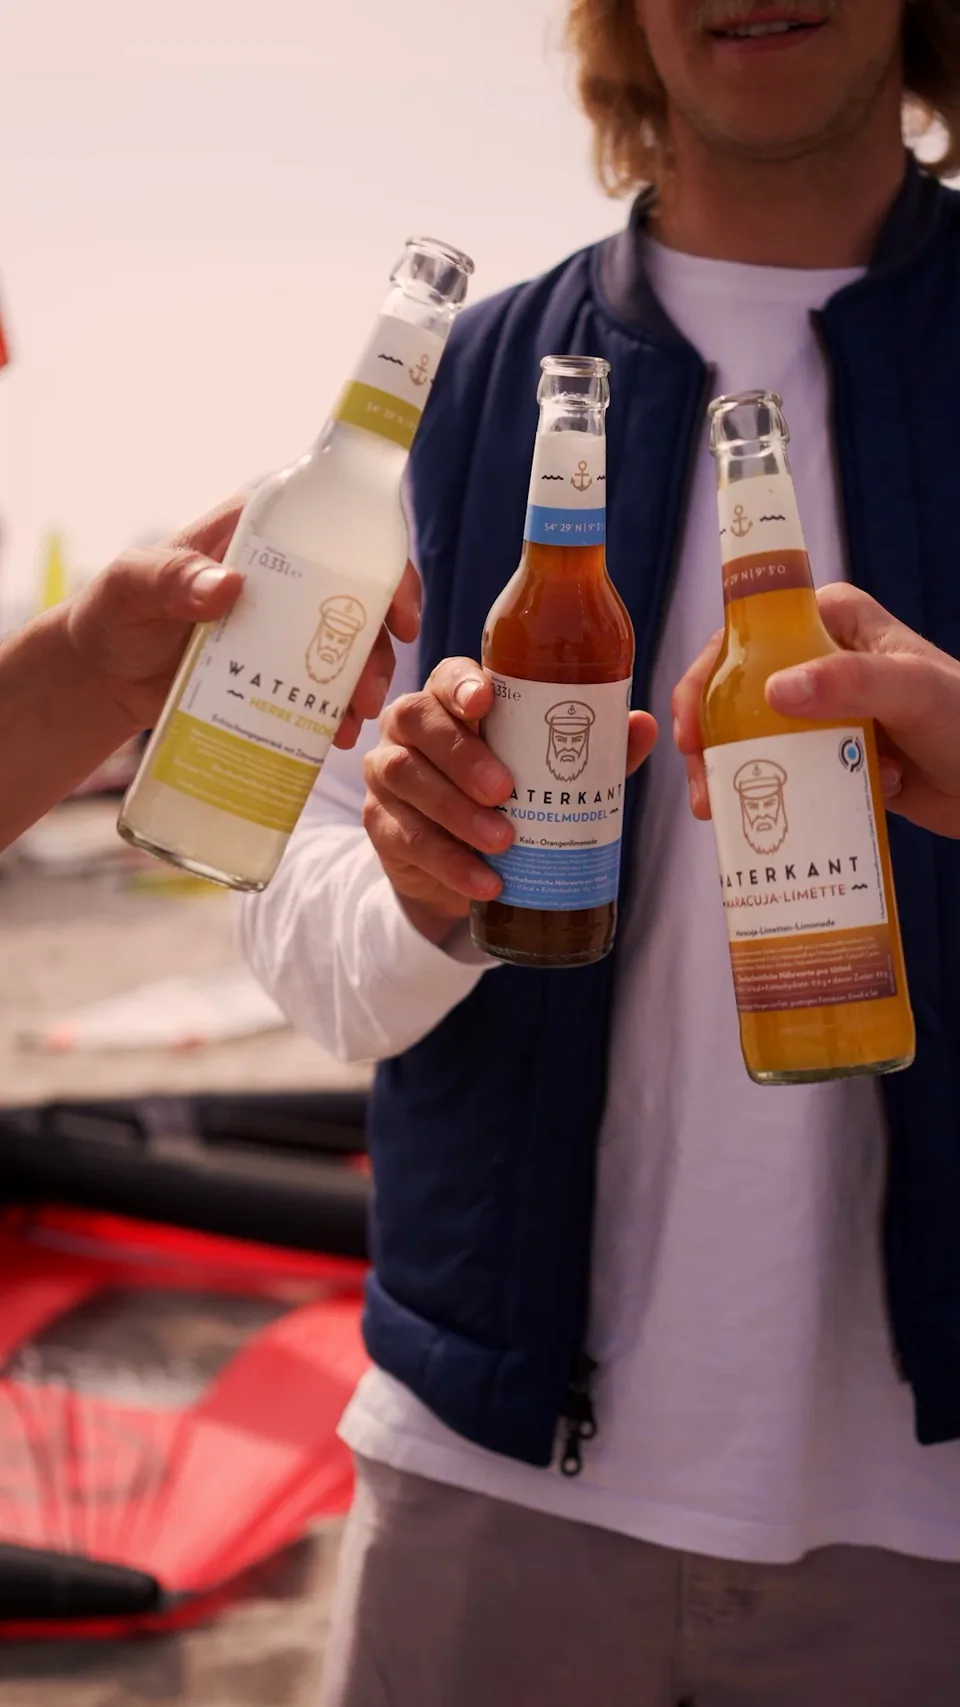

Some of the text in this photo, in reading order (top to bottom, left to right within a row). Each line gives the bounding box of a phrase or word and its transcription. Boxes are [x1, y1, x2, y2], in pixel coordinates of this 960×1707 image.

[248, 696, 294, 724] HERBE
[510, 783, 622, 805] ATERKANT
[511, 807, 608, 823] KUDDELMUDDEL
[520, 836, 535, 845] Kola
